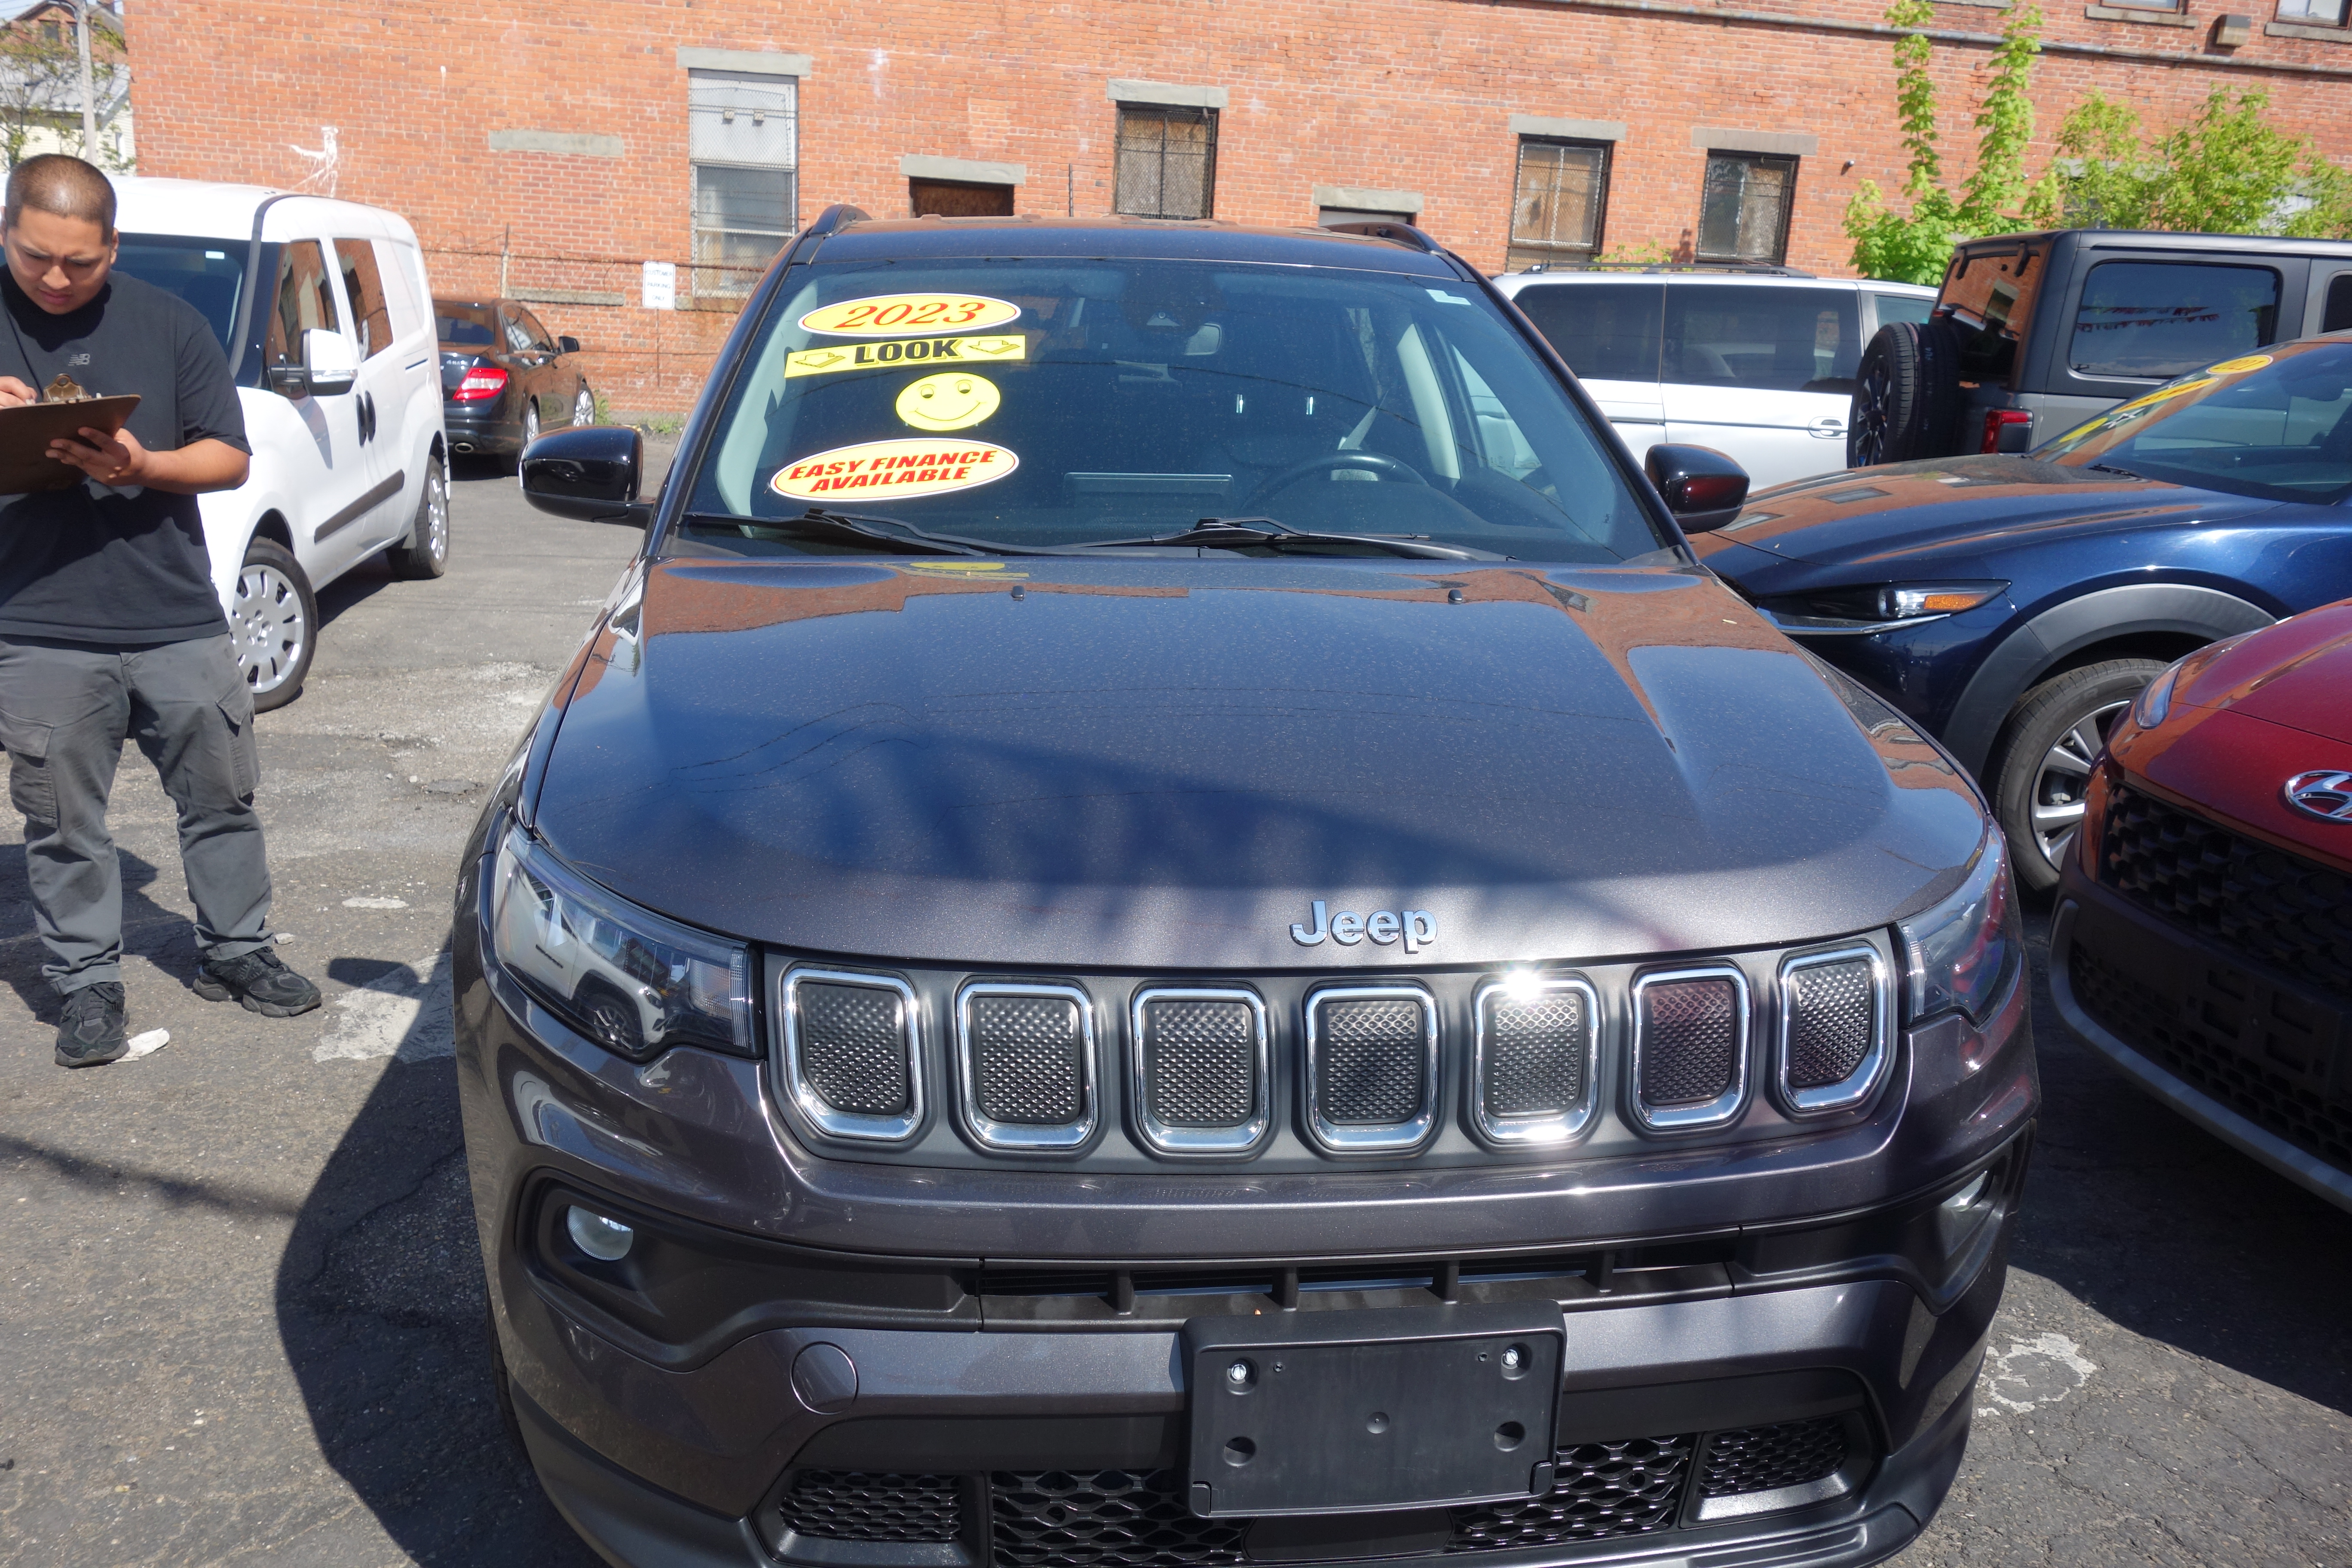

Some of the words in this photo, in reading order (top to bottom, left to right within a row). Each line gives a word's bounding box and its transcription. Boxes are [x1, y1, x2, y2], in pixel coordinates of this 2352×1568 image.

[834, 302, 985, 328] 2023
[854, 339, 962, 365] LOOK
[788, 459, 865, 480] EASY
[870, 451, 998, 470] FINANCE
[809, 467, 971, 492] AVAILABLE
[1289, 900, 1437, 954] Jeep
